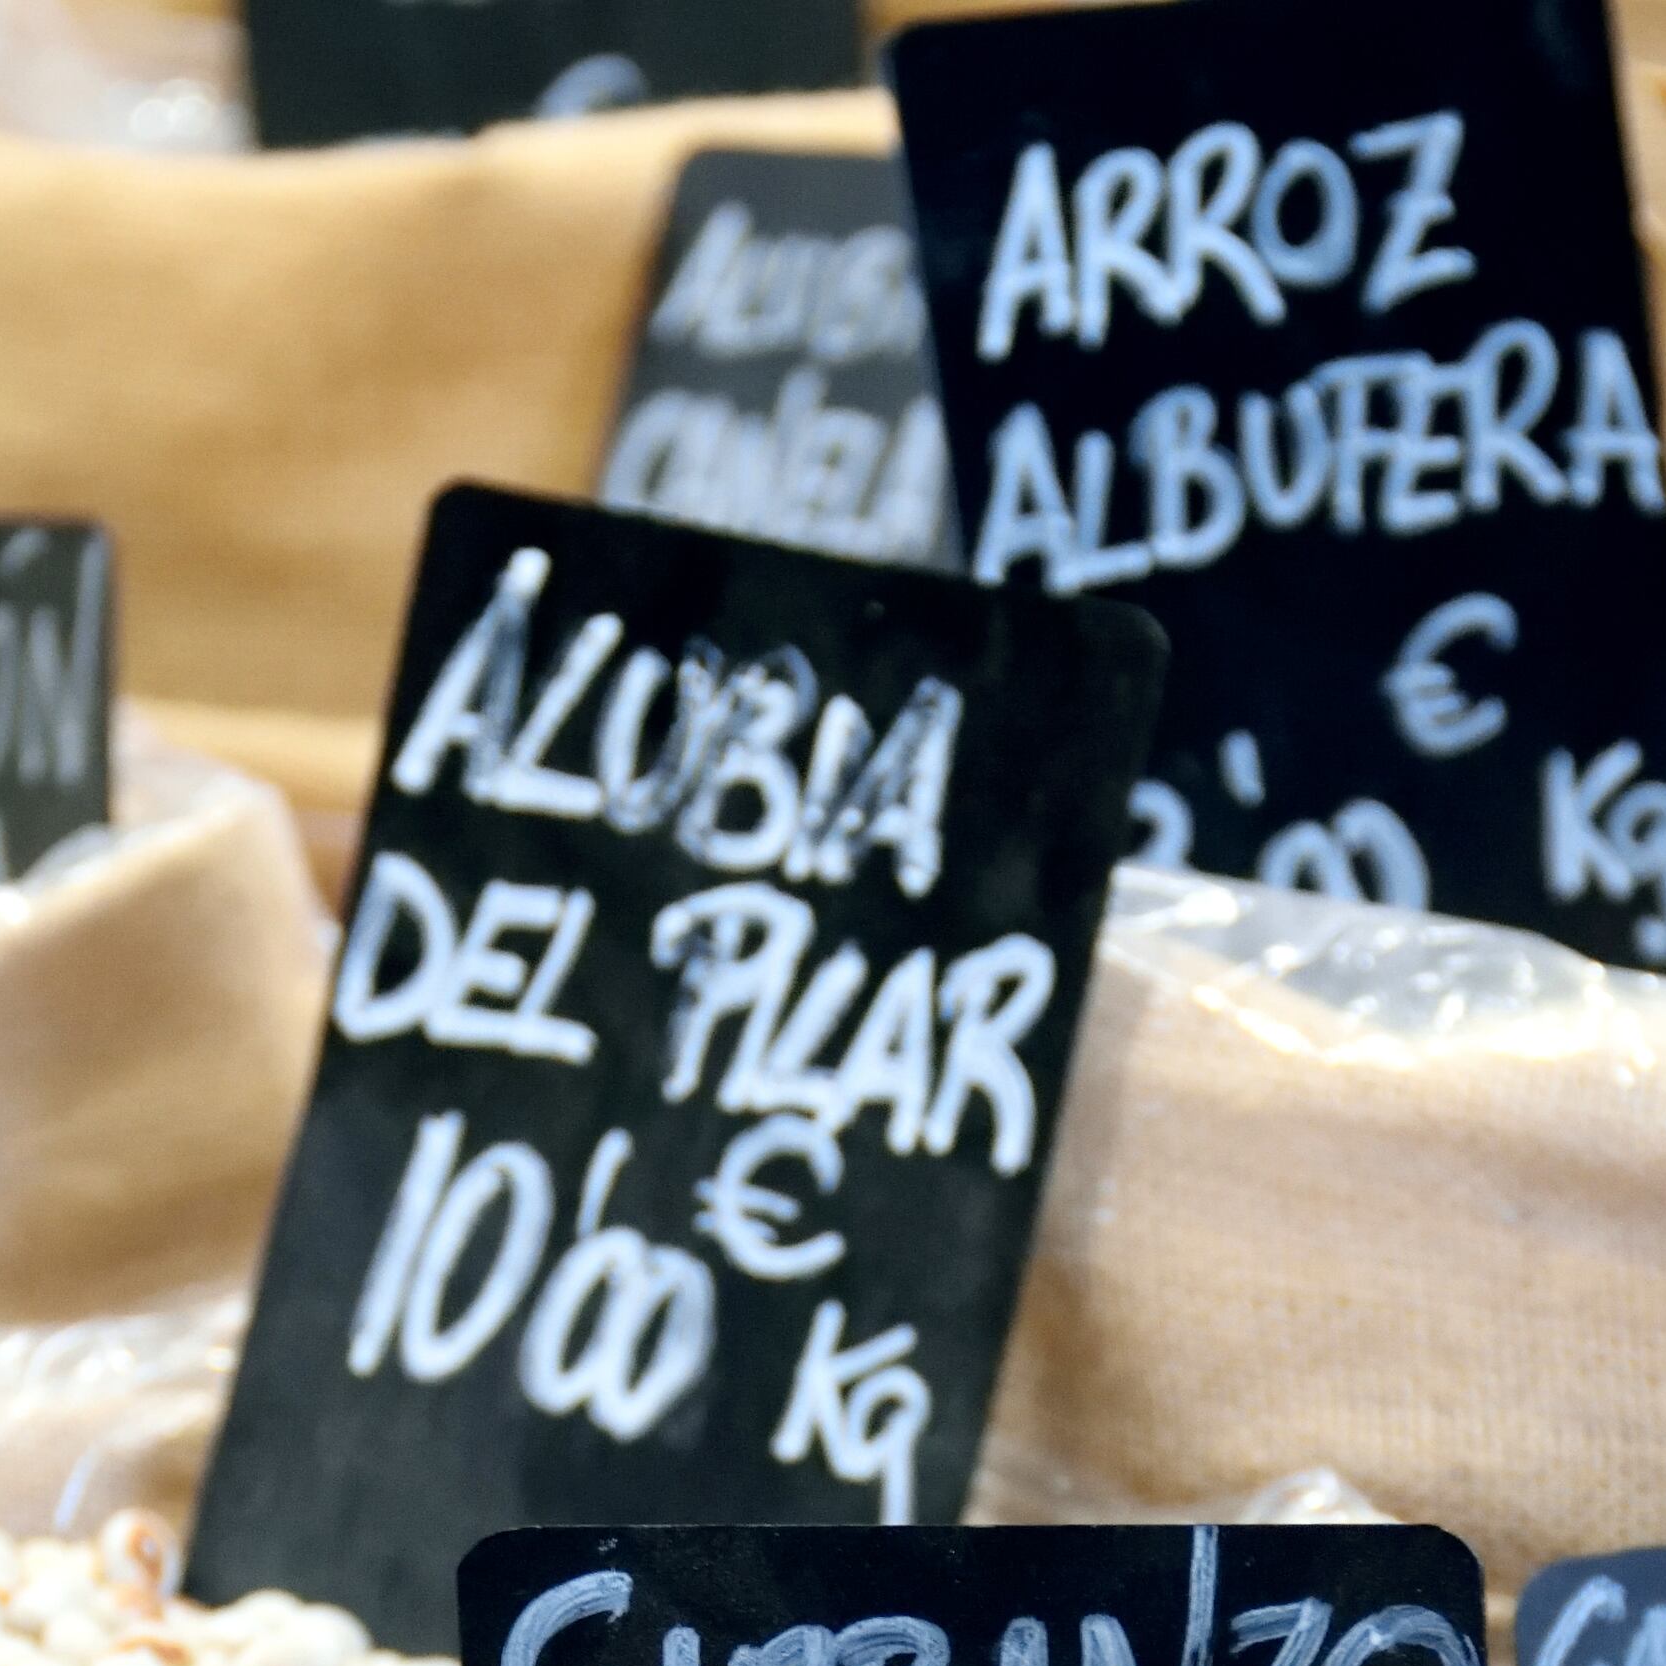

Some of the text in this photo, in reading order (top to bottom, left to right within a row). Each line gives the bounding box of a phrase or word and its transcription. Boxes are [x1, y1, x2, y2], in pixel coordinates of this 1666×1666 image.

[978, 110, 1477, 363] ARROZ
[391, 544, 964, 897] ALUBIA
[1383, 592, 1517, 757] €
[332, 852, 1056, 1173] DEL PILAR
[694, 1113, 845, 1278] €
